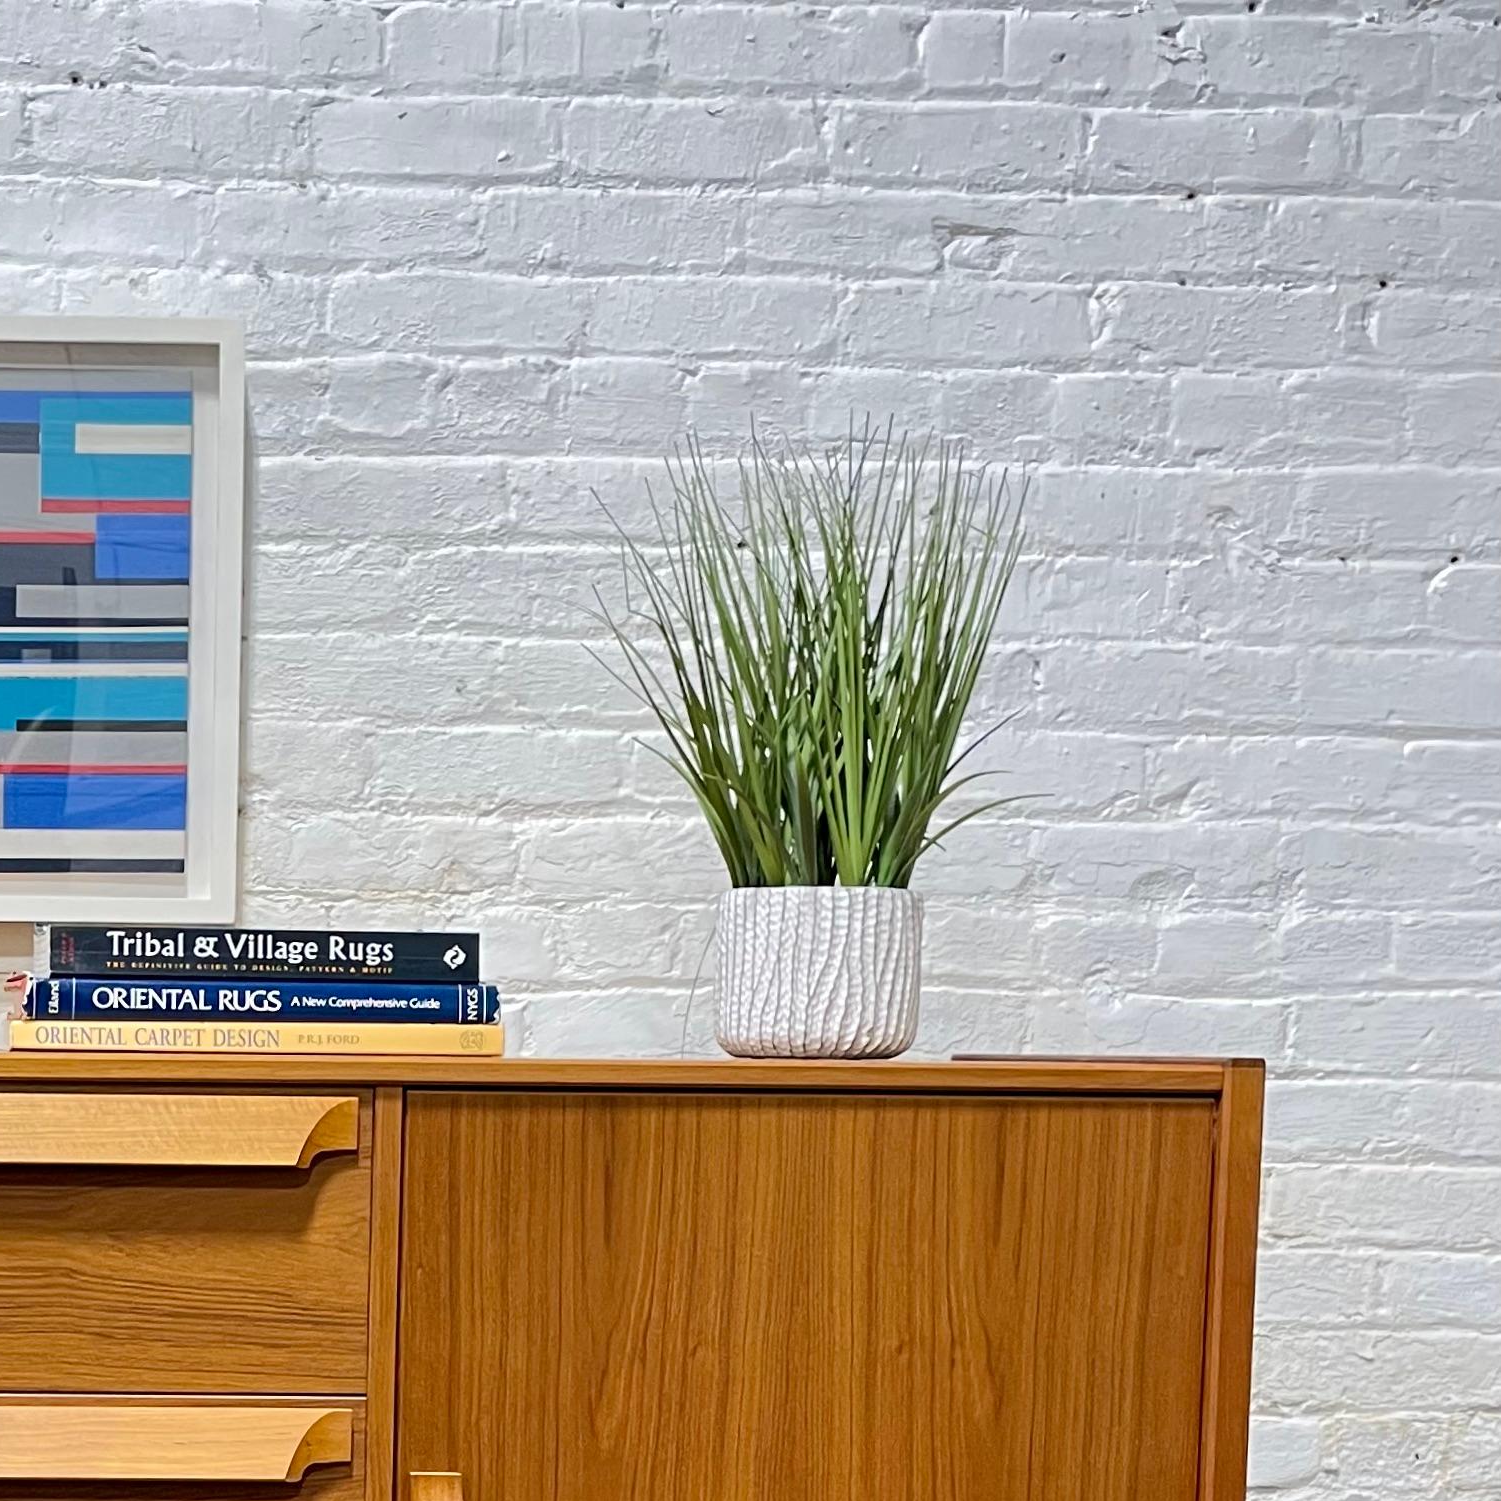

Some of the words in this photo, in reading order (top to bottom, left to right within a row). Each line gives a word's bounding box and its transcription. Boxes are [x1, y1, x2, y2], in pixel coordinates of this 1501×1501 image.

[106, 930, 184, 957] Tribal
[193, 936, 219, 958] &
[224, 933, 319, 964] Village
[329, 935, 394, 966] Rugs
[92, 986, 211, 1011] ORIENTAL
[218, 989, 282, 1012] RUGS
[290, 996, 300, 1007] A
[302, 996, 327, 1008] New
[328, 996, 407, 1011] Comprehensive
[409, 997, 441, 1010] Guide
[35, 1025, 127, 1046] ORIENTAL
[134, 1027, 205, 1047] CARPET
[213, 1028, 280, 1048] DESIGN
[327, 1033, 360, 1046] FORD
